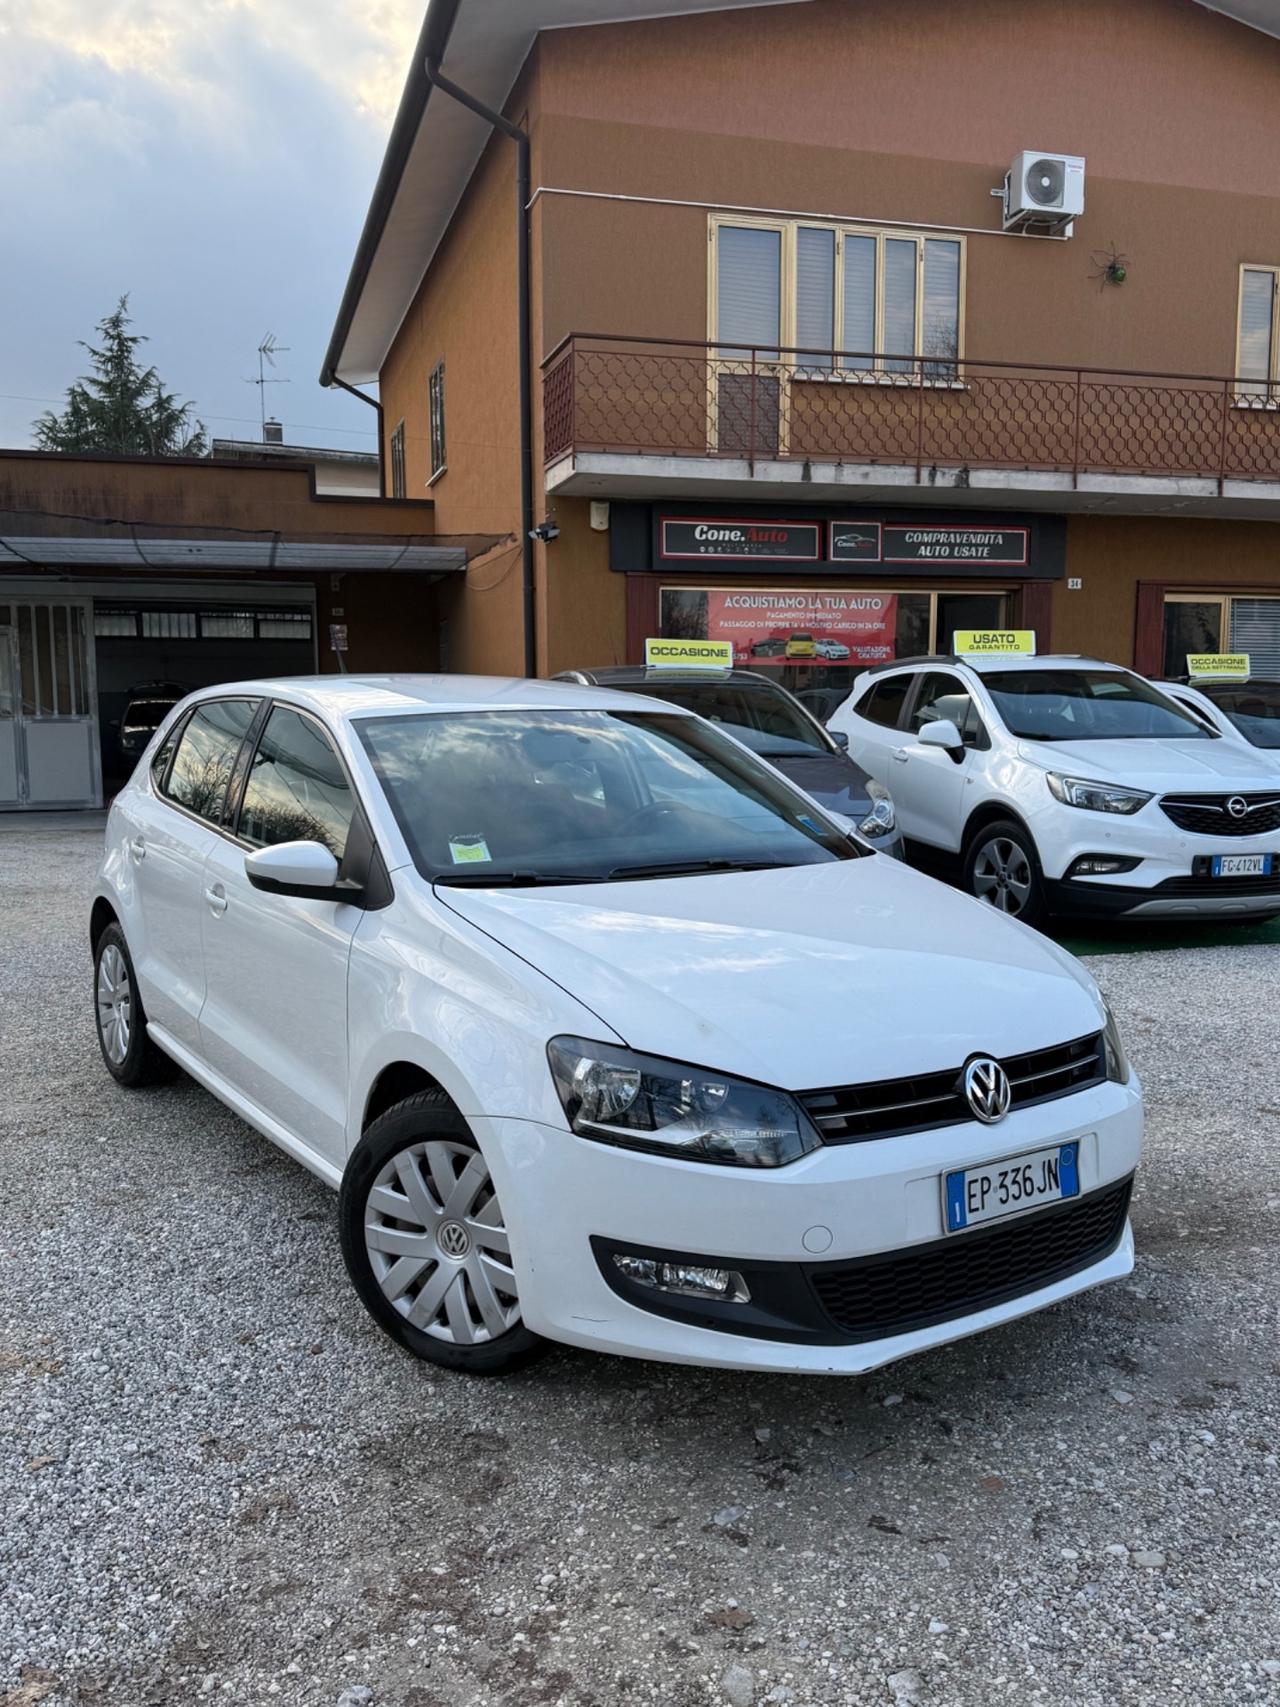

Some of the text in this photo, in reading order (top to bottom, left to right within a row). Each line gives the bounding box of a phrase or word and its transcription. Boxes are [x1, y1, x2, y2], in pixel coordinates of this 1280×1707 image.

[694, 525, 788, 542] Cone.Auto
[905, 532, 1003, 544] COMPRAVENDITA
[917, 546, 991, 557] AUTO USATE
[724, 596, 882, 610] ACQUISTIAMO LA TUA AUTO
[806, 612, 842, 620] IMMEDIATO
[719, 620, 756, 628] PASSAGGIO
[973, 634, 1015, 643] USATO
[650, 646, 729, 658] OCCASIONE
[967, 1176, 992, 1213] EP
